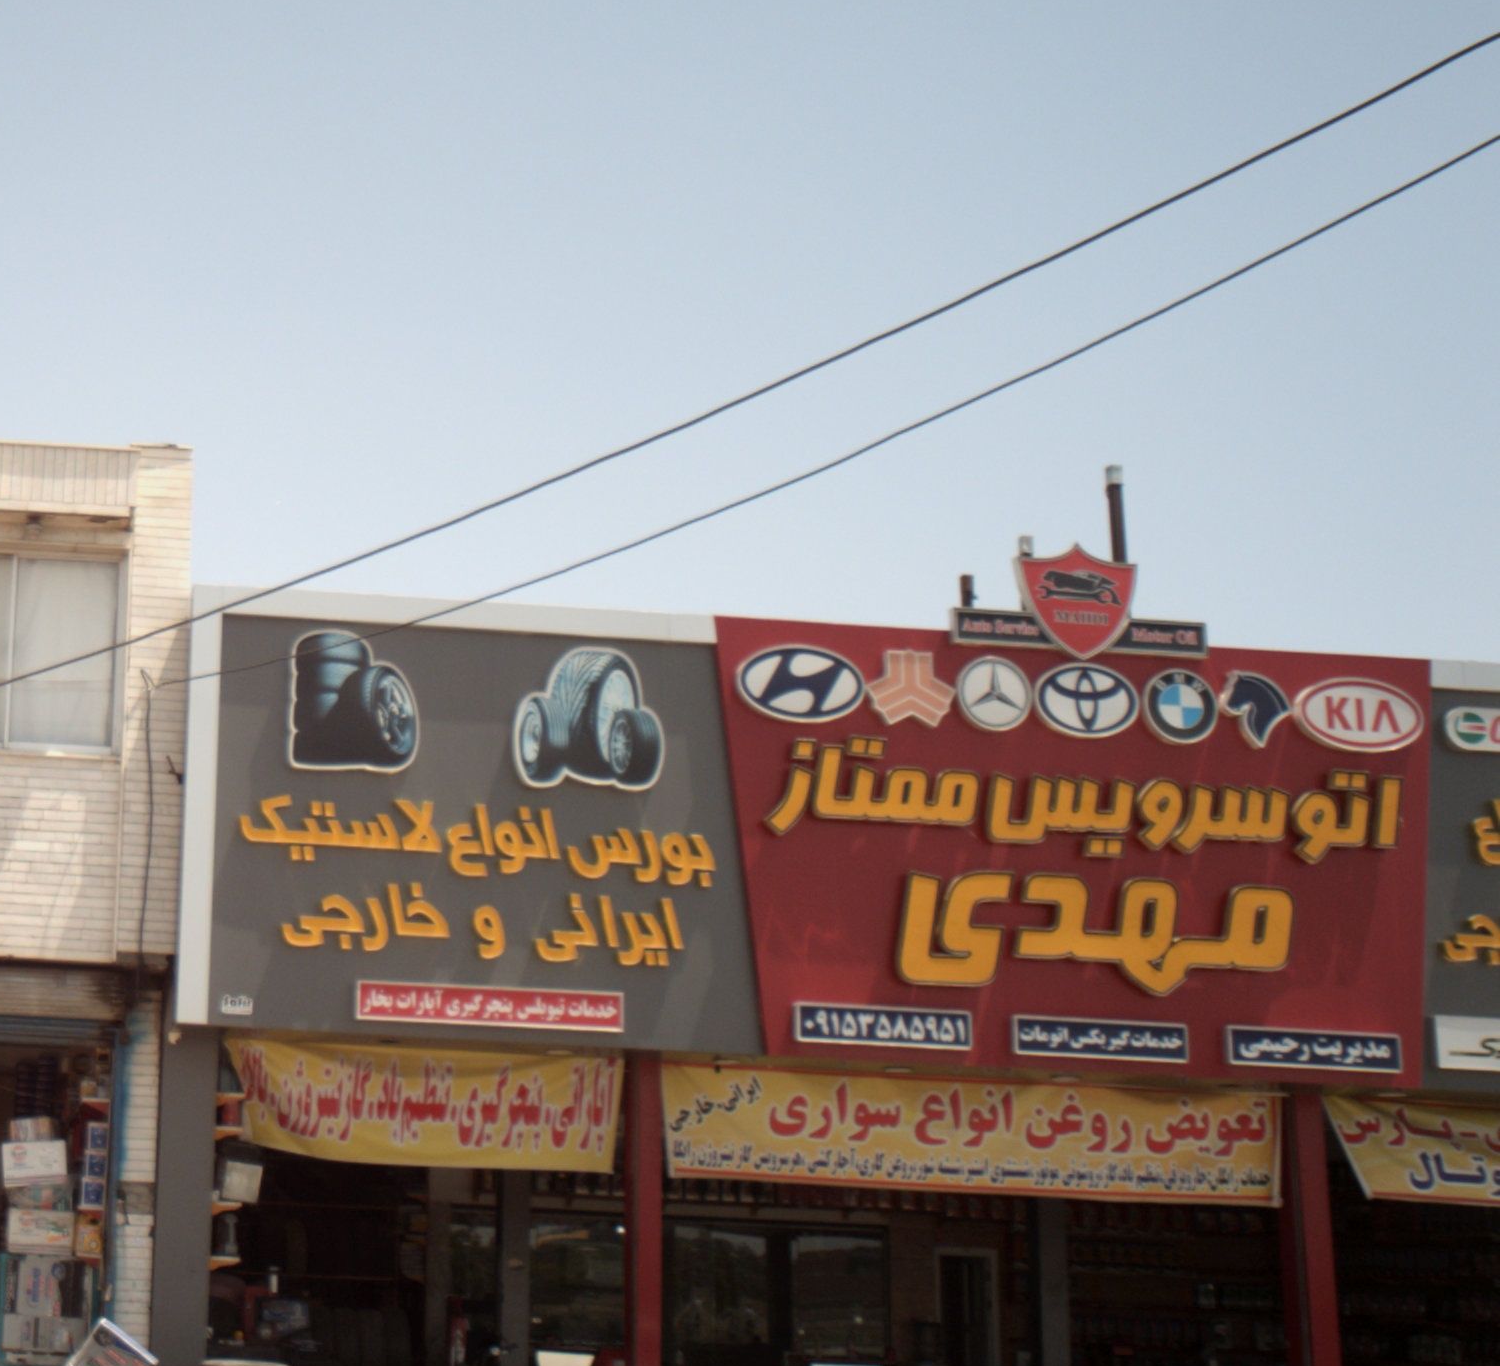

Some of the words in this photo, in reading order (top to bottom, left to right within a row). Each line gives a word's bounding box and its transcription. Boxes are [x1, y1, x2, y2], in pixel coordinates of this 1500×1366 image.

[962, 617, 991, 633] Auto
[995, 618, 1041, 636] Service
[1131, 628, 1174, 646] Motor
[1175, 630, 1199, 647] Oil
[1154, 671, 1205, 695] BMW
[1325, 694, 1402, 735] KIA
[764, 735, 980, 835] ممتاز
[239, 795, 443, 861] لاستیک
[447, 803, 561, 877] انواع
[567, 827, 716, 887] بورس
[281, 882, 451, 953] خارجی
[473, 904, 506, 960] و
[534, 893, 684, 967] ایرانی
[899, 871, 1295, 996] مهدی
[568, 998, 618, 1019] خدمات
[803, 1009, 967, 1043] ۰۹۱۵۳۵۸۵۹۵۱
[1019, 1024, 1070, 1048] اتومات
[1132, 1031, 1184, 1051] خدمات
[1239, 1036, 1311, 1063] رحیمی
[1312, 1037, 1392, 1065] مدیریت
[769, 1083, 901, 1141] سواری
[915, 1087, 1014, 1147] انواع
[1026, 1093, 1133, 1154] روغن
[1146, 1097, 1267, 1157] تعویض
